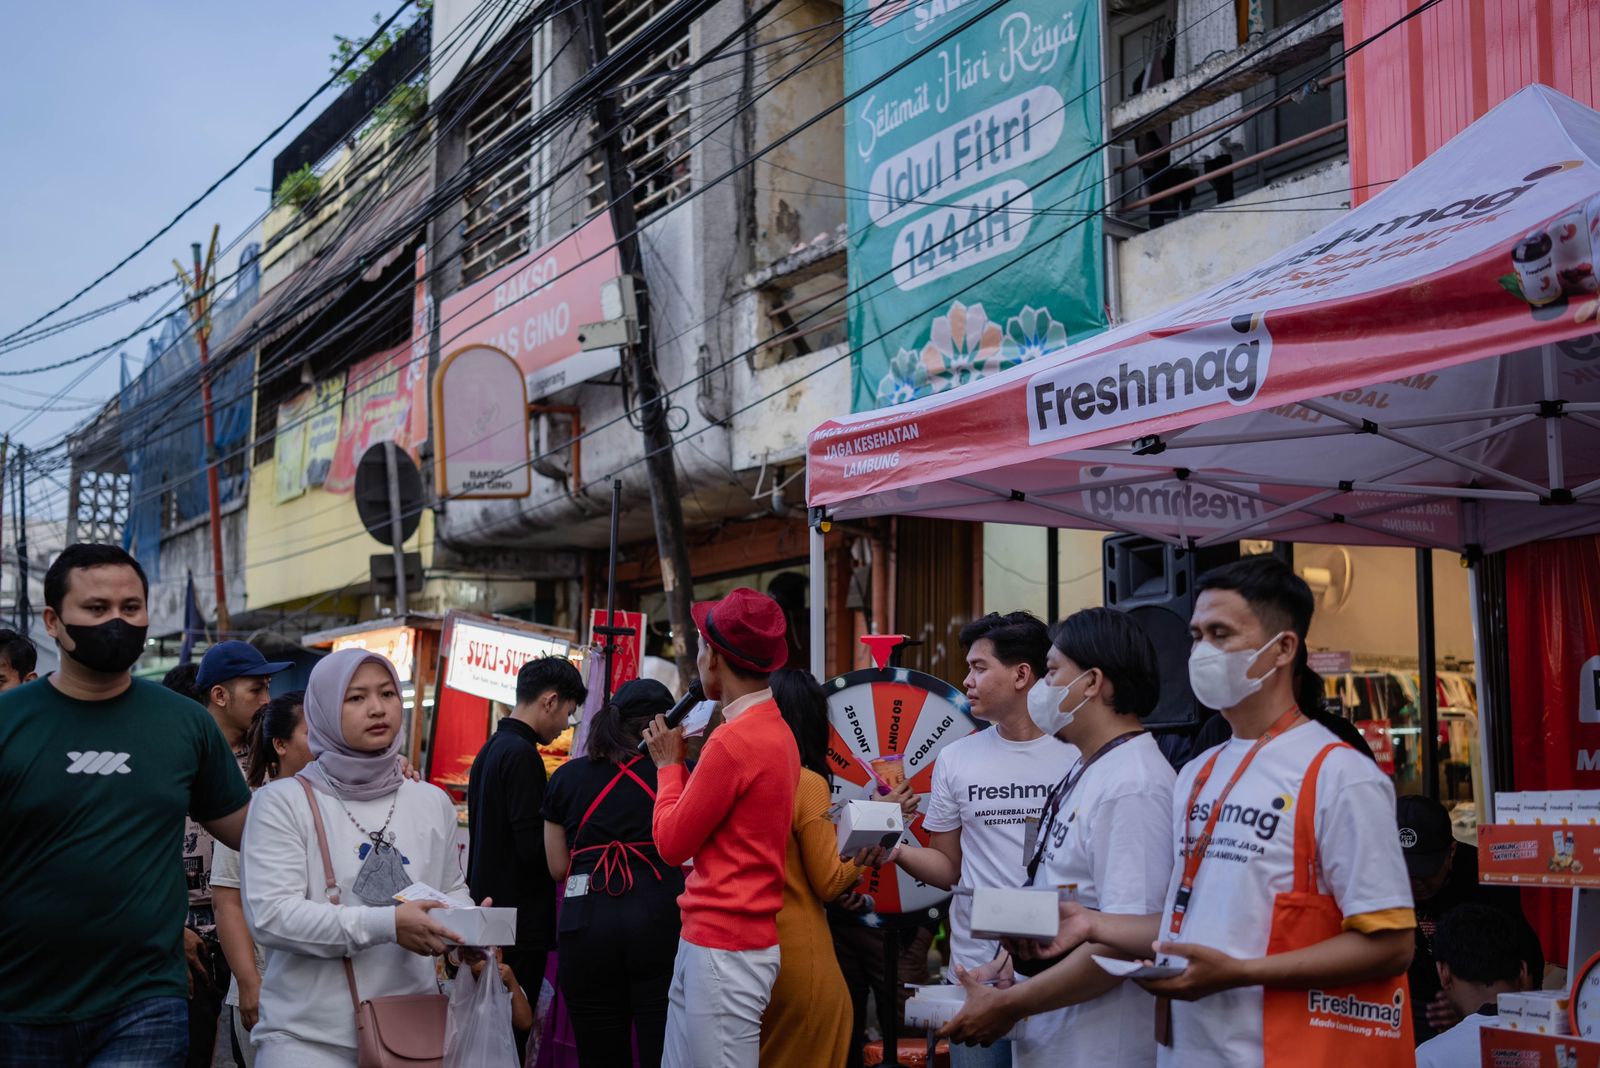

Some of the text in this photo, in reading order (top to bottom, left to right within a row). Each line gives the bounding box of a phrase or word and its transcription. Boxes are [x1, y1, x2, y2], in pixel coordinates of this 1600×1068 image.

[885, 98, 1031, 214] Idul Fitri
[905, 190, 1011, 280] 1444H
[494, 256, 558, 317] BAKSO
[523, 301, 570, 352] GINO
[1033, 336, 1261, 430] Freshmag
[824, 441, 853, 461] JAGA
[854, 422, 920, 454] KESEHATAN
[843, 451, 900, 479] LAMBUNG
[844, 705, 871, 754] 25 POINT
[887, 715, 901, 752] POINT
[909, 715, 955, 767] COBA LAGI
[826, 747, 851, 770] OINT
[974, 809, 997, 817] MADU
[997, 808, 1025, 816] HERBAL
[1238, 841, 1265, 855] JAGA
[1591, 976, 1600, 986] 10
[1309, 989, 1402, 1029] Freshmag
